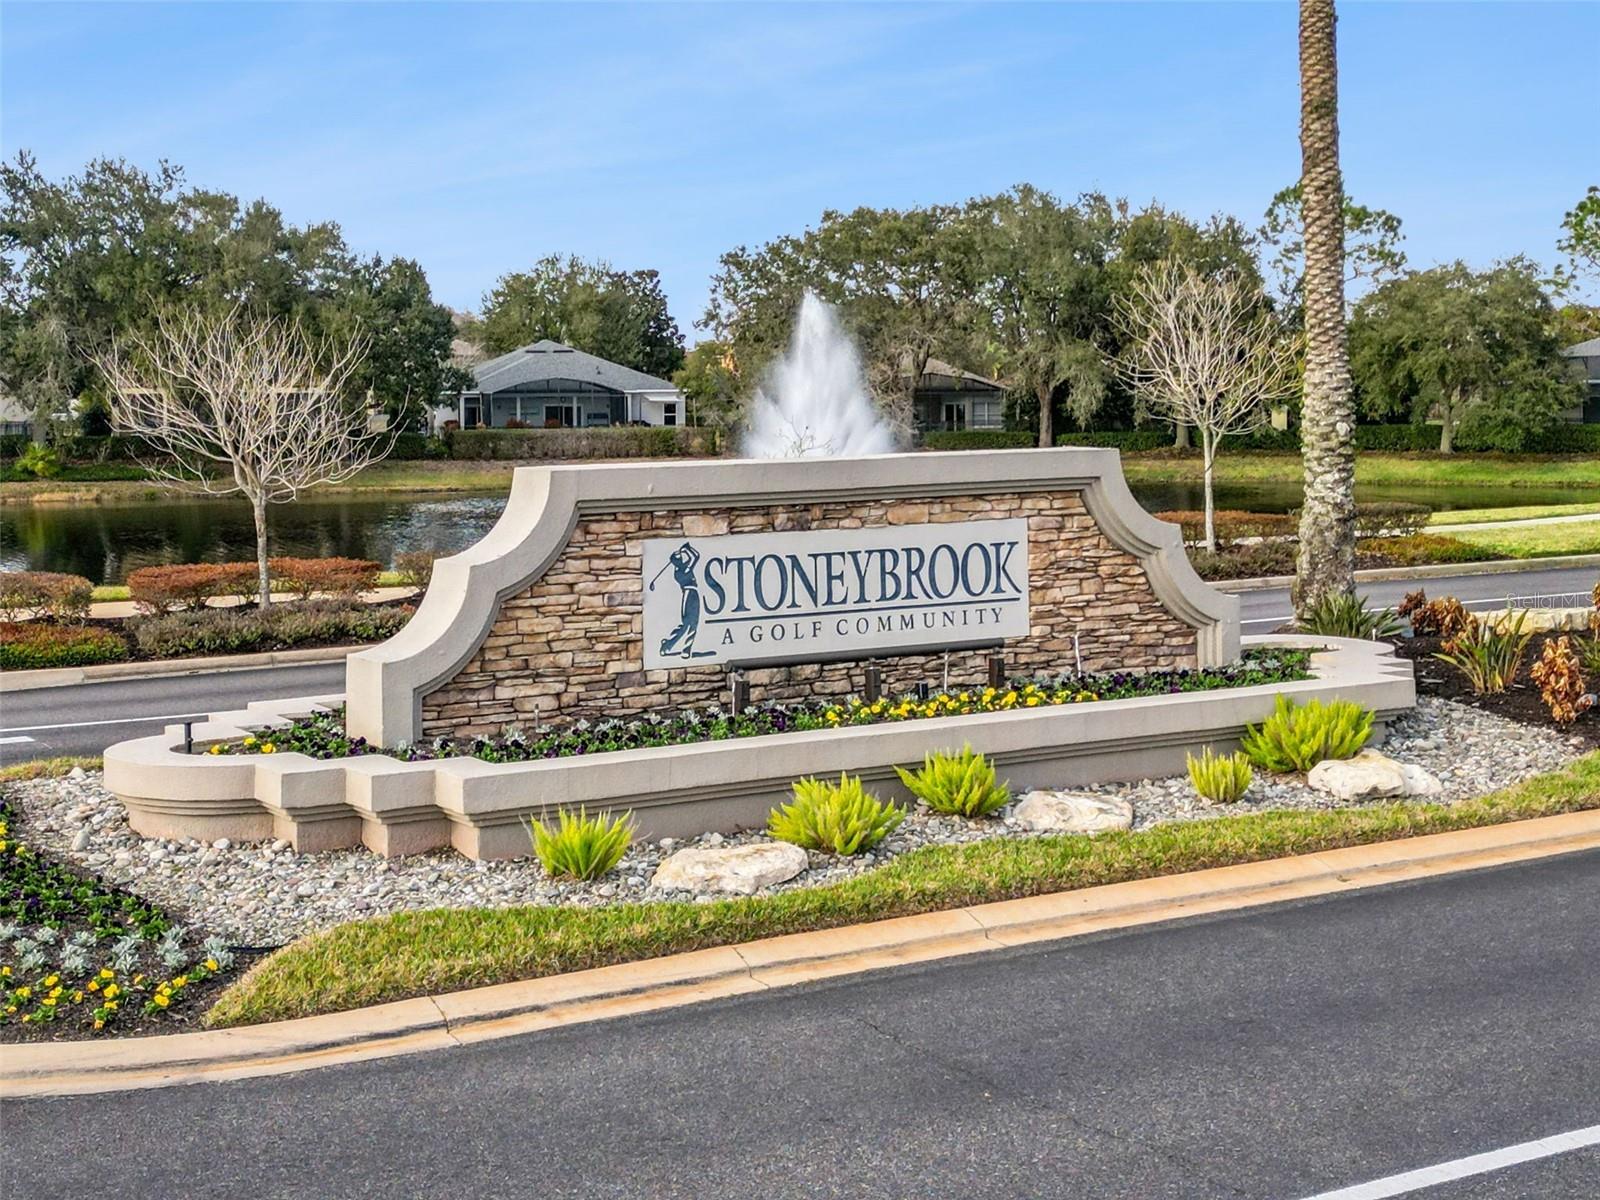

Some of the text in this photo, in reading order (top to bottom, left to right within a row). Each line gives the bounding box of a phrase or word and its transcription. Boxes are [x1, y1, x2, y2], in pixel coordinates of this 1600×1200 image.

[703, 541, 1022, 615] STONEYBROOK
[721, 607, 1003, 645] A GOLF COMMUNITY
